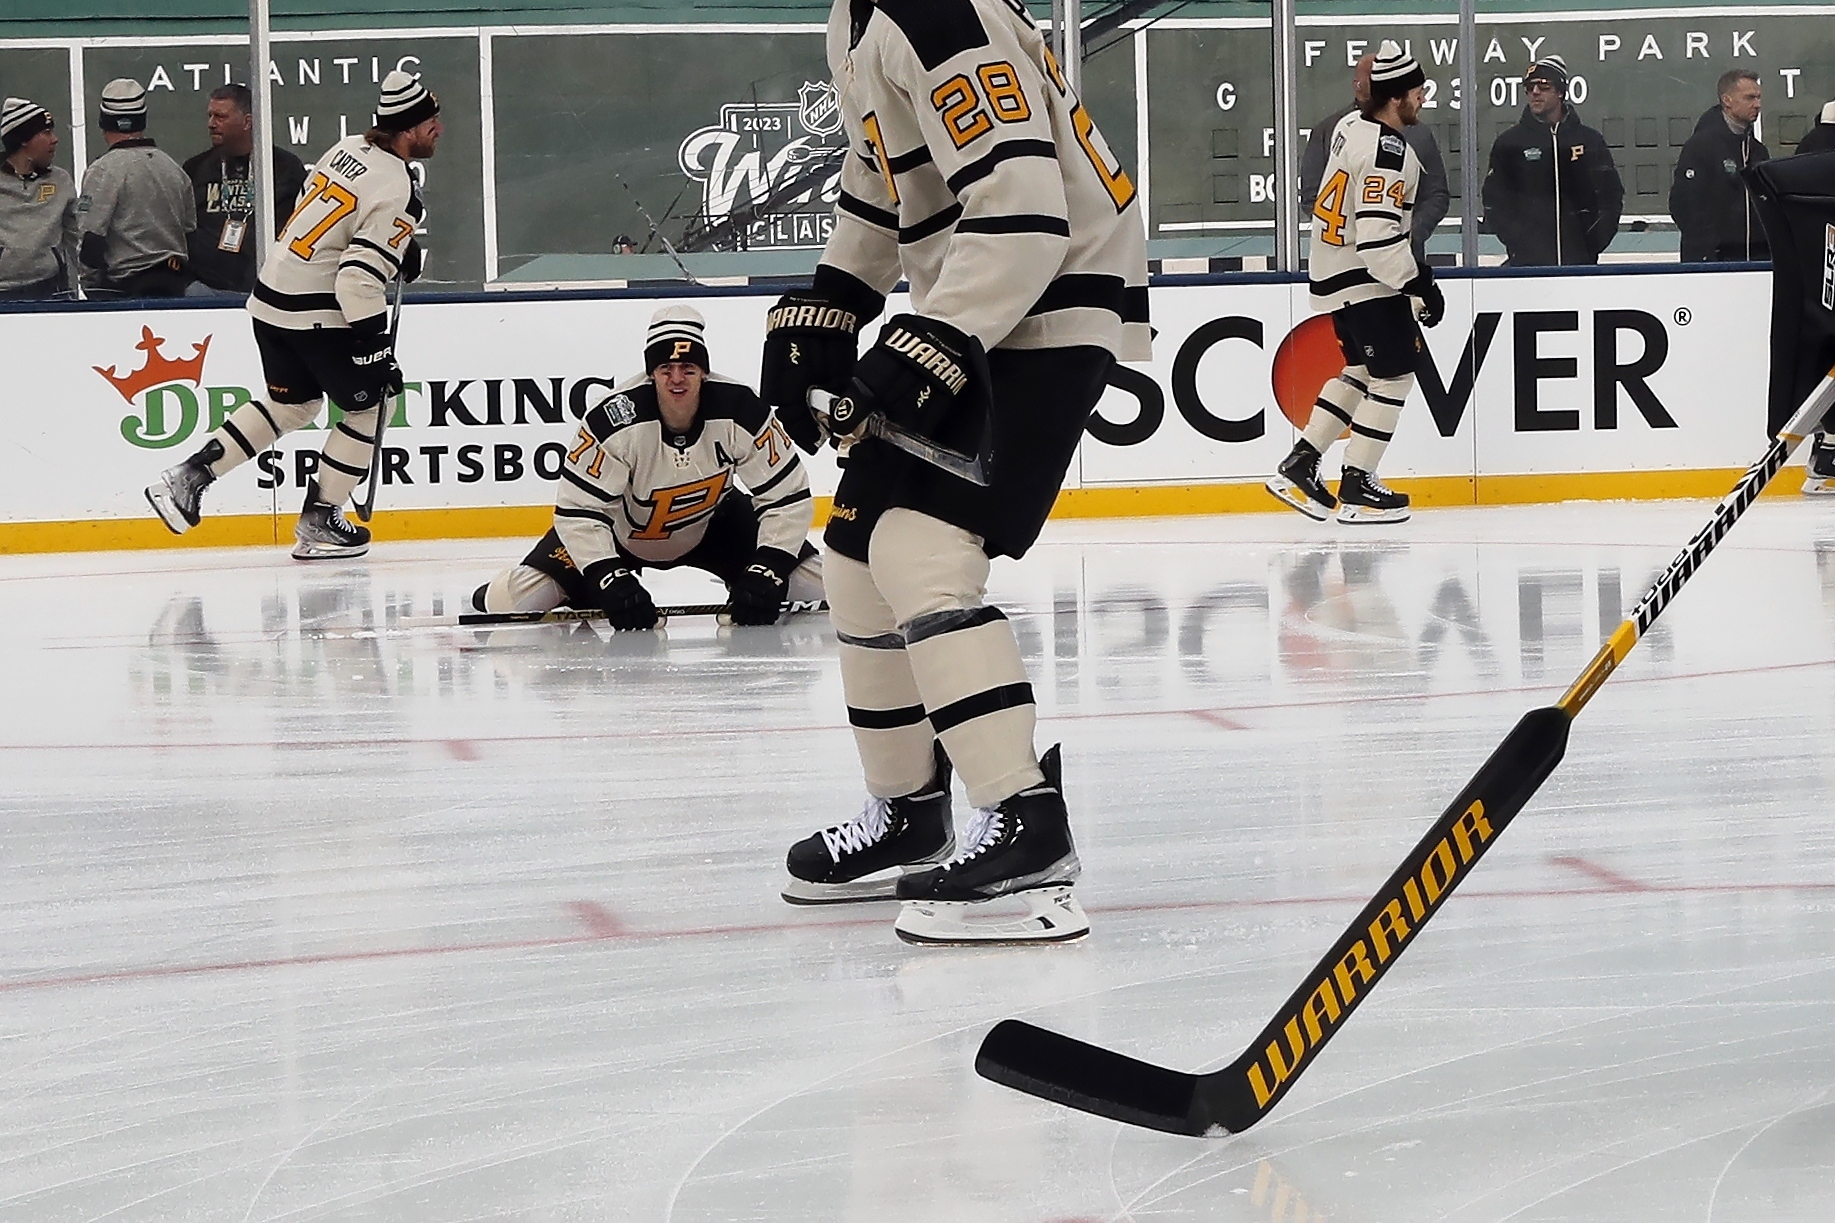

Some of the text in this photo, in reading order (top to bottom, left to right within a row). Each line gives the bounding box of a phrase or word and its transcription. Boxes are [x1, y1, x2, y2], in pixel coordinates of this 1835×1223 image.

[1599, 30, 1758, 61] PARK
[147, 56, 422, 92] ATLANTIC
[809, 96, 836, 123] NHL
[931, 61, 1031, 151] 28
[1216, 82, 1237, 110] G
[289, 116, 309, 144] W
[328, 150, 368, 181] CARTER
[1570, 145, 1584, 161] P
[37, 184, 57, 203] P
[1363, 176, 1405, 208] 24
[277, 171, 357, 261] 77
[753, 218, 833, 241] CLAS
[388, 217, 415, 249] 7
[669, 341, 692, 359] P
[885, 328, 968, 395] WARRI
[567, 429, 607, 478] 71
[714, 441, 735, 467] A
[754, 418, 792, 467] 71
[628, 468, 732, 540] P
[1638, 441, 1788, 637] WARRIOR
[1246, 798, 1494, 1109] WARRIOR
